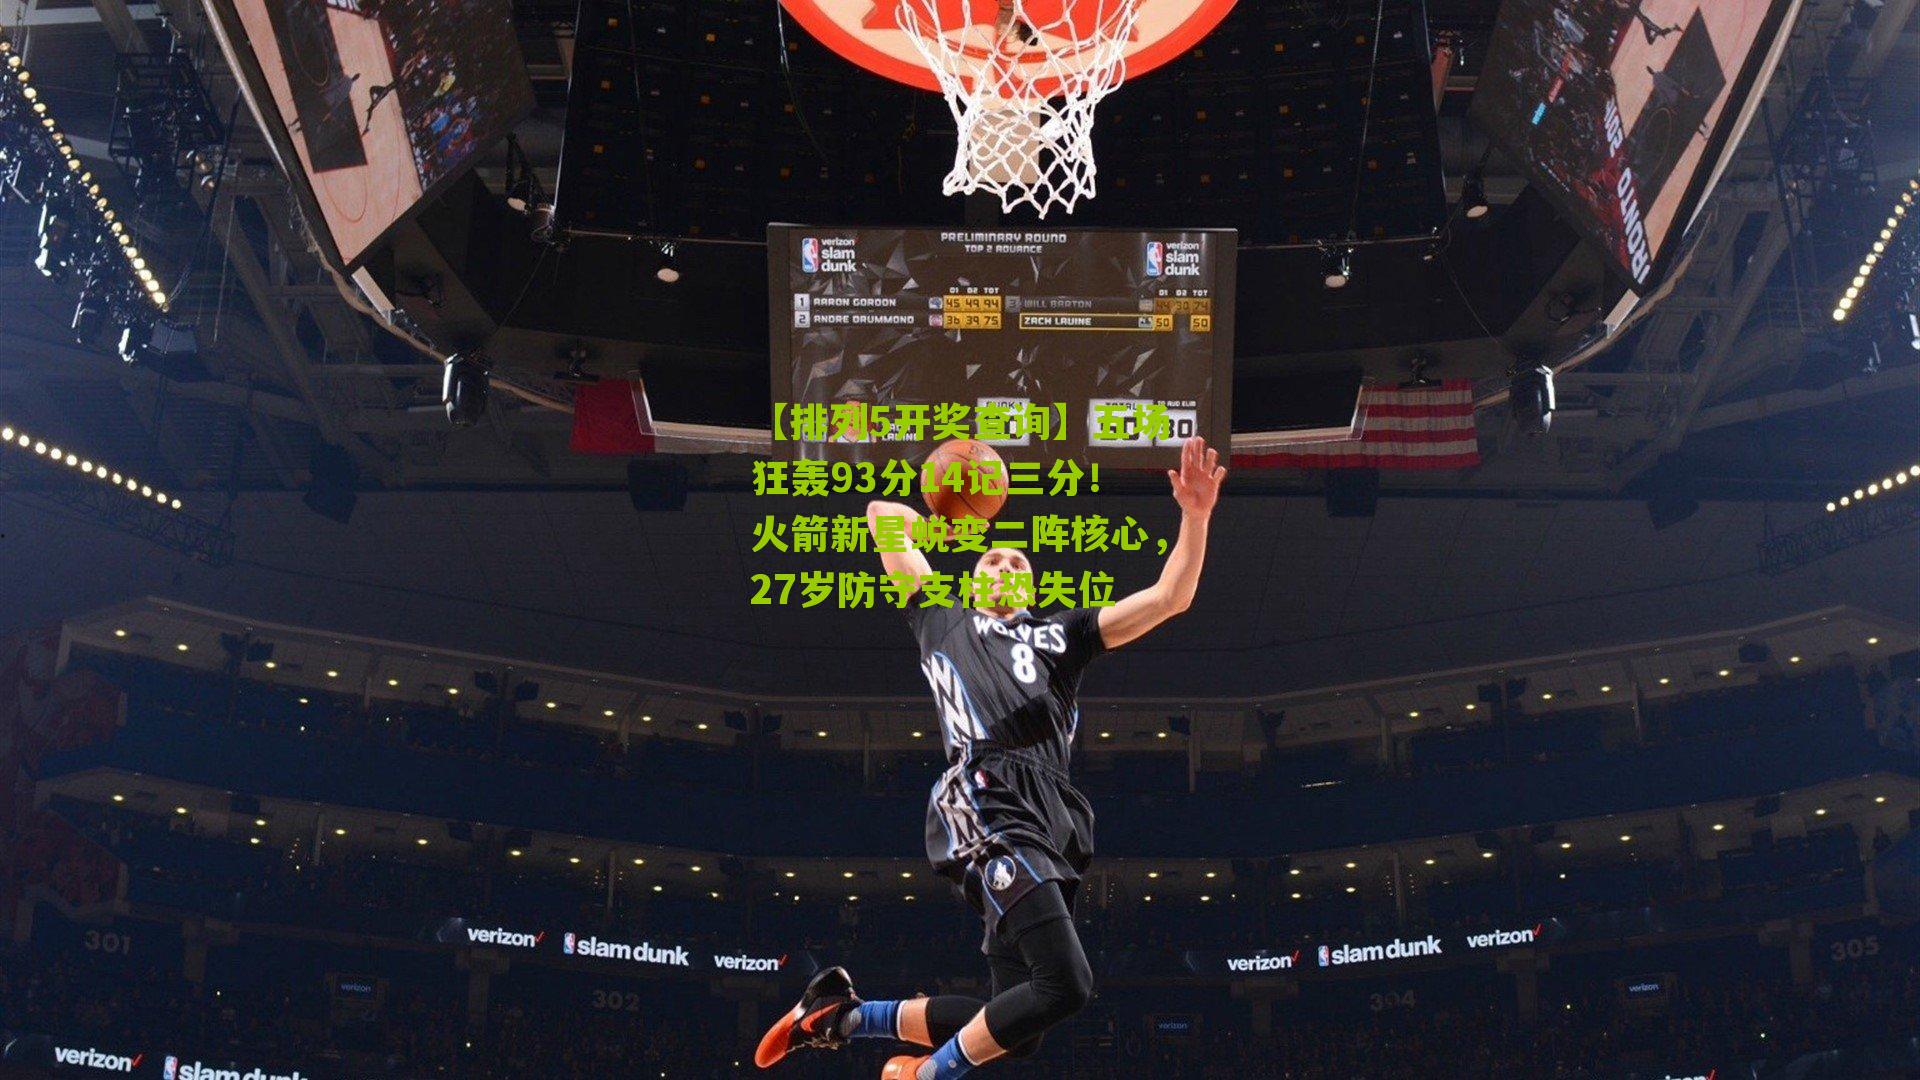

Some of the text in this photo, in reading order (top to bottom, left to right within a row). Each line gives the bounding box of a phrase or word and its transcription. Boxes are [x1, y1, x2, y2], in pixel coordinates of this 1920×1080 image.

[821, 237, 855, 246] verizon
[941, 232, 1067, 243] PRELIMINARY ROUND
[965, 245, 984, 253] TOP
[987, 245, 993, 253] 2
[1166, 242, 1200, 250] verizon
[821, 247, 856, 259] slam
[1165, 252, 1200, 264] slam
[821, 260, 857, 272] dunk
[1165, 264, 1200, 276] dunk
[799, 297, 999, 310] 1 AARON GORDON 45 49 94
[1024, 299, 1048, 308] WILL
[1050, 300, 1092, 309] BARTON
[799, 314, 806, 325] 2
[814, 315, 850, 324] ANDRE
[852, 315, 915, 325] DRUMMOND
[966, 315, 980, 326] 39
[984, 315, 999, 326] 75
[1024, 316, 1208, 328] ZACH LAVINE 50 50
[1011, 643, 1037, 684] 8
[467, 927, 536, 948] verizon
[1466, 929, 1534, 948] verizon
[577, 937, 690, 967] slam dunk
[1331, 935, 1443, 965] slam dunk
[1831, 935, 1880, 961] 305
[714, 954, 779, 972] verizon
[1227, 954, 1292, 972] verizon
[340, 982, 372, 993] verizon
[1628, 982, 1660, 993] verizon
[1159, 1020, 1188, 1030] verizon
[55, 1046, 132, 1073] verizon
